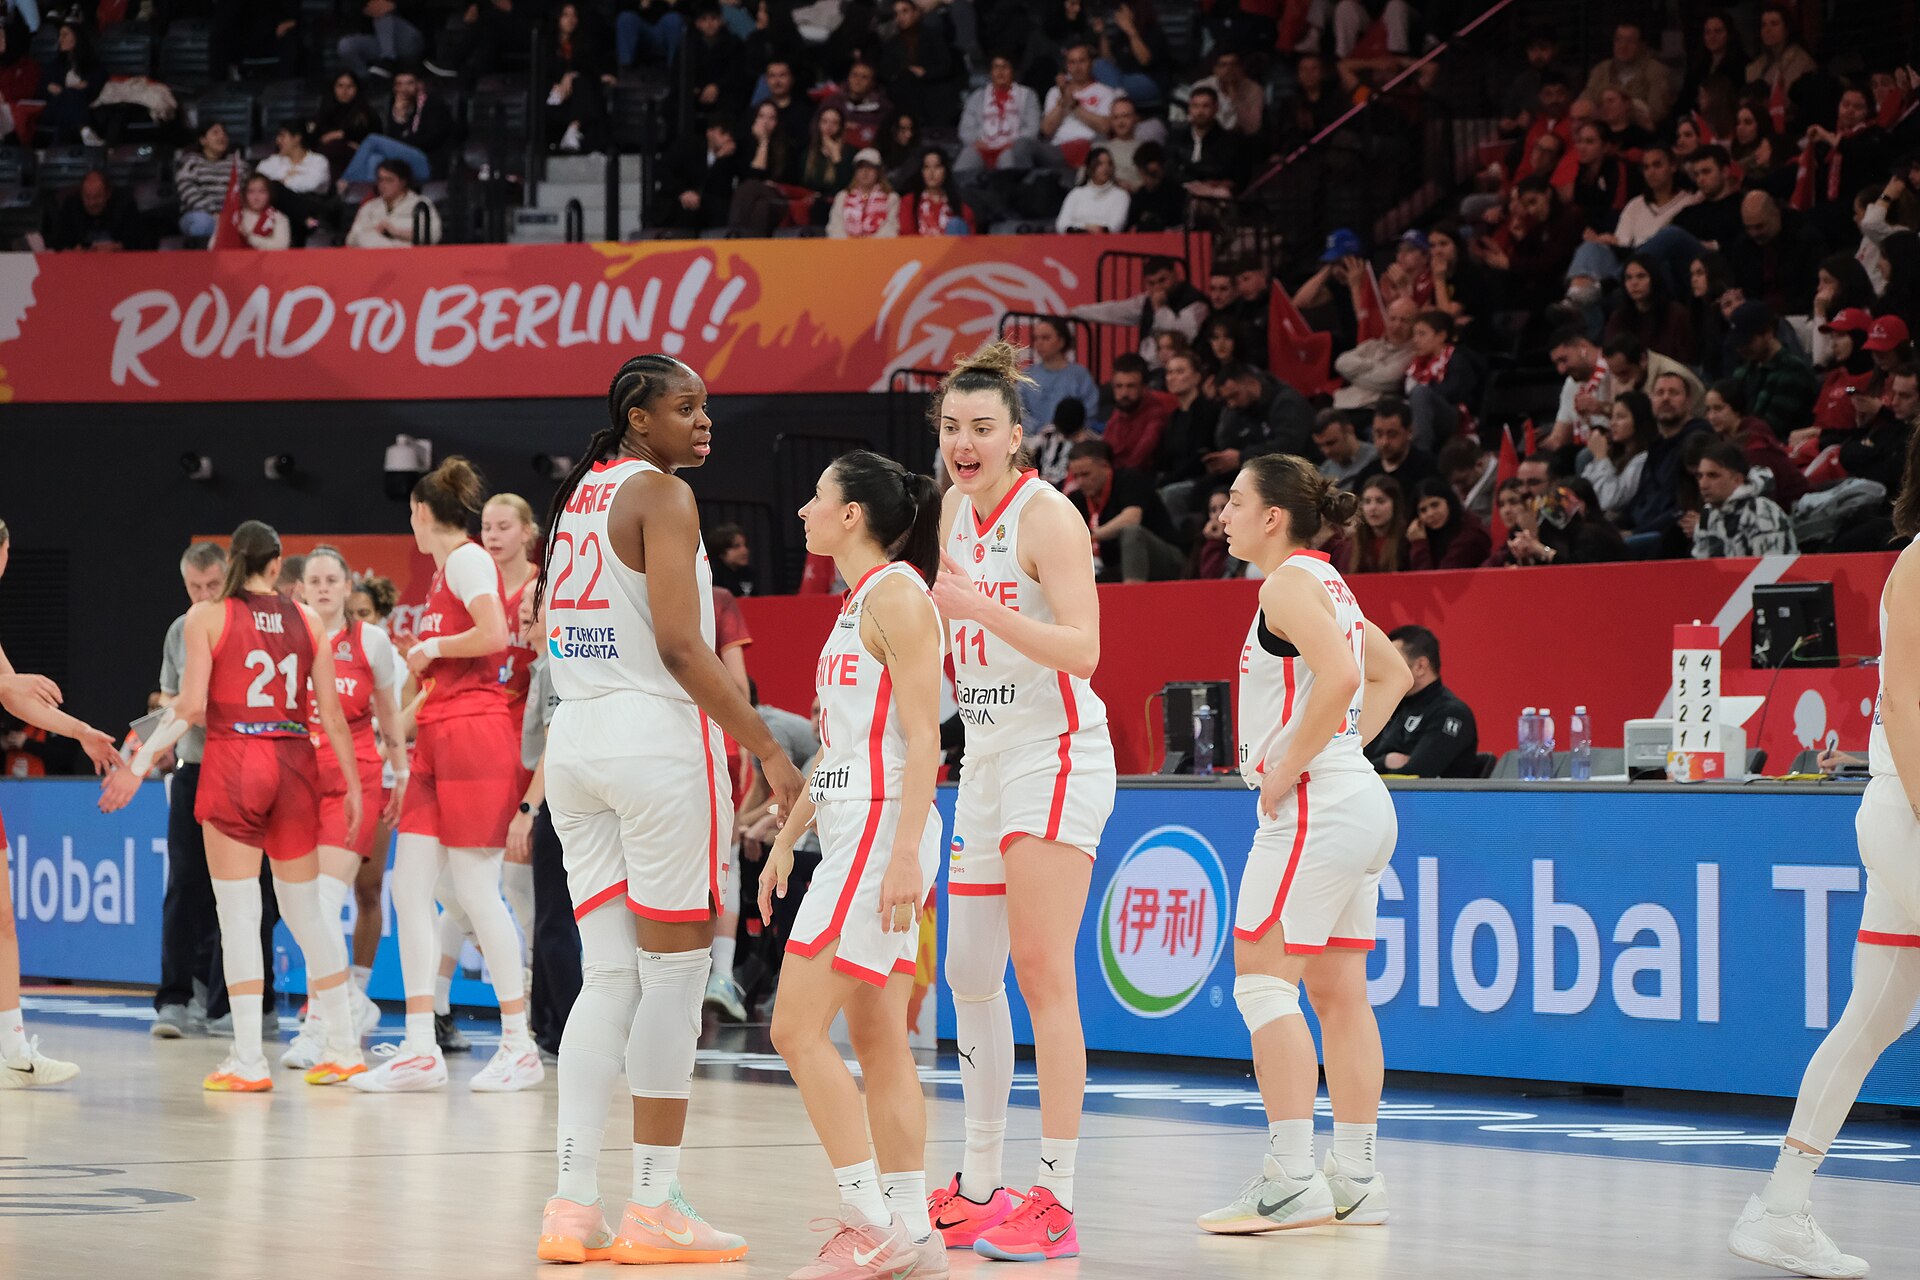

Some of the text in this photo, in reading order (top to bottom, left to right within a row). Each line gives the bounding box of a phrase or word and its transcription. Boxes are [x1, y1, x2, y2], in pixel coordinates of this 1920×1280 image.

[110, 256, 747, 387] ROAD TO BERLIN!!
[566, 483, 617, 514] URKE
[550, 531, 610, 610] 22
[955, 626, 988, 666] 11
[1679, 654, 1712, 672] 4 4
[245, 649, 298, 709] 21
[1679, 679, 1711, 697] 3 3
[1679, 704, 1713, 722] 2 2
[1680, 730, 1711, 748] 1 1
[8, 834, 135, 925] lobal
[1117, 885, 1206, 957] 伊利
[1772, 864, 1862, 1029] T
